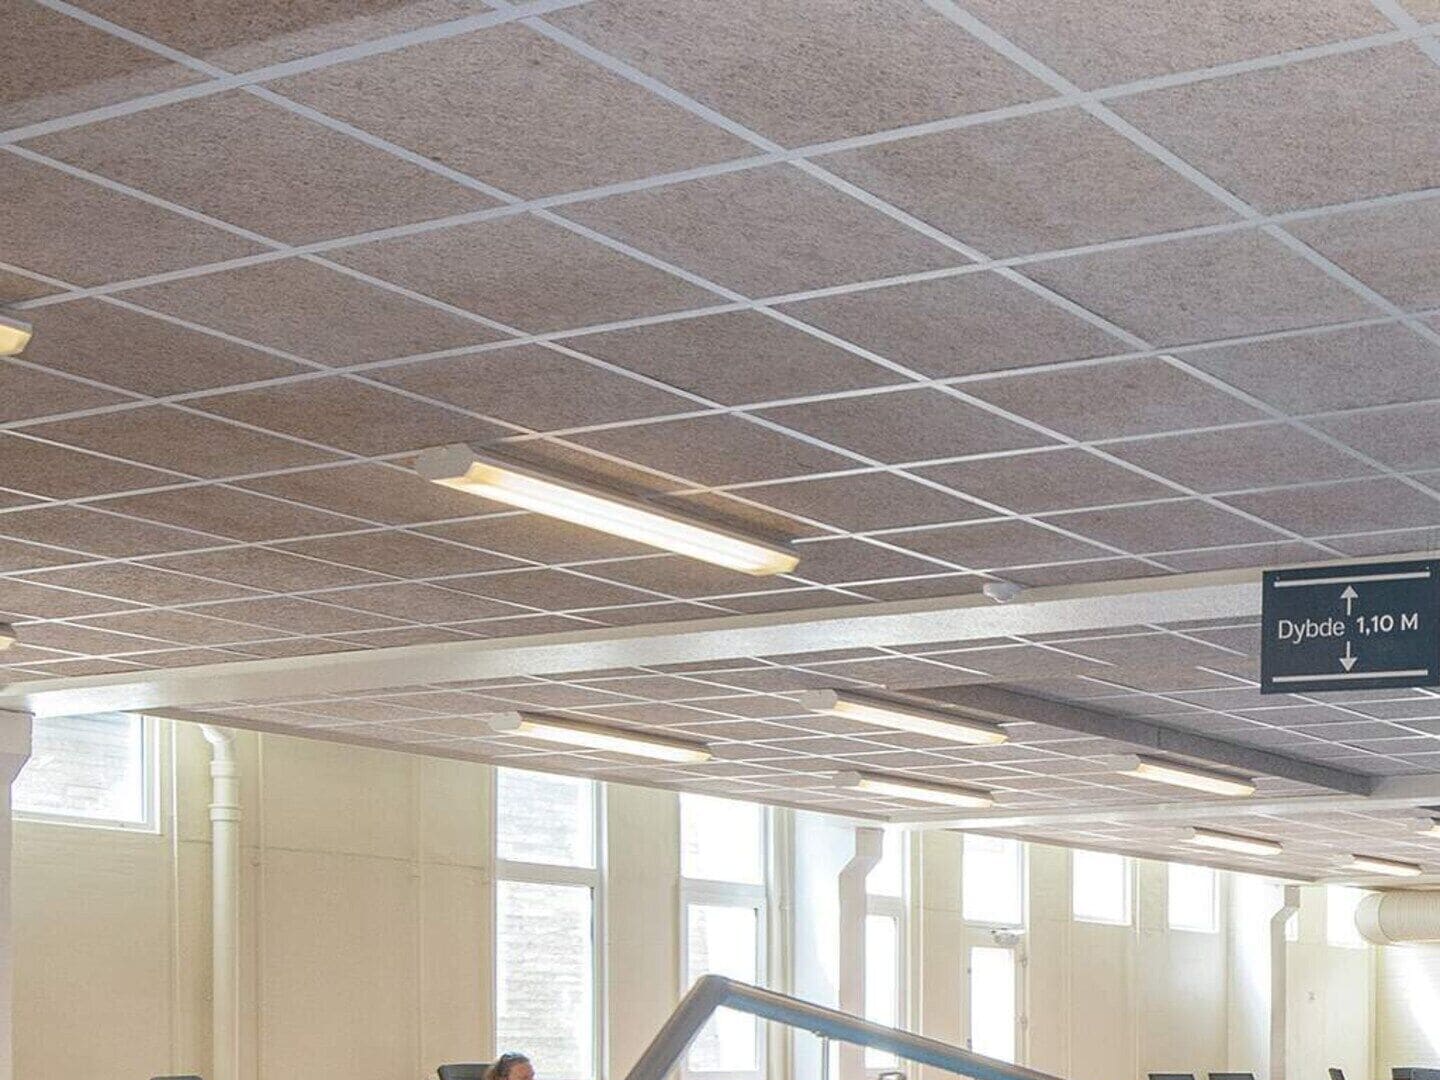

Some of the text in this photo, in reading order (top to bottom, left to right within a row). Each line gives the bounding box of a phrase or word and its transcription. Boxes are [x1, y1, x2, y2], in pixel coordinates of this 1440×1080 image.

[1278, 613, 1418, 644] Dybde 1,10 M
